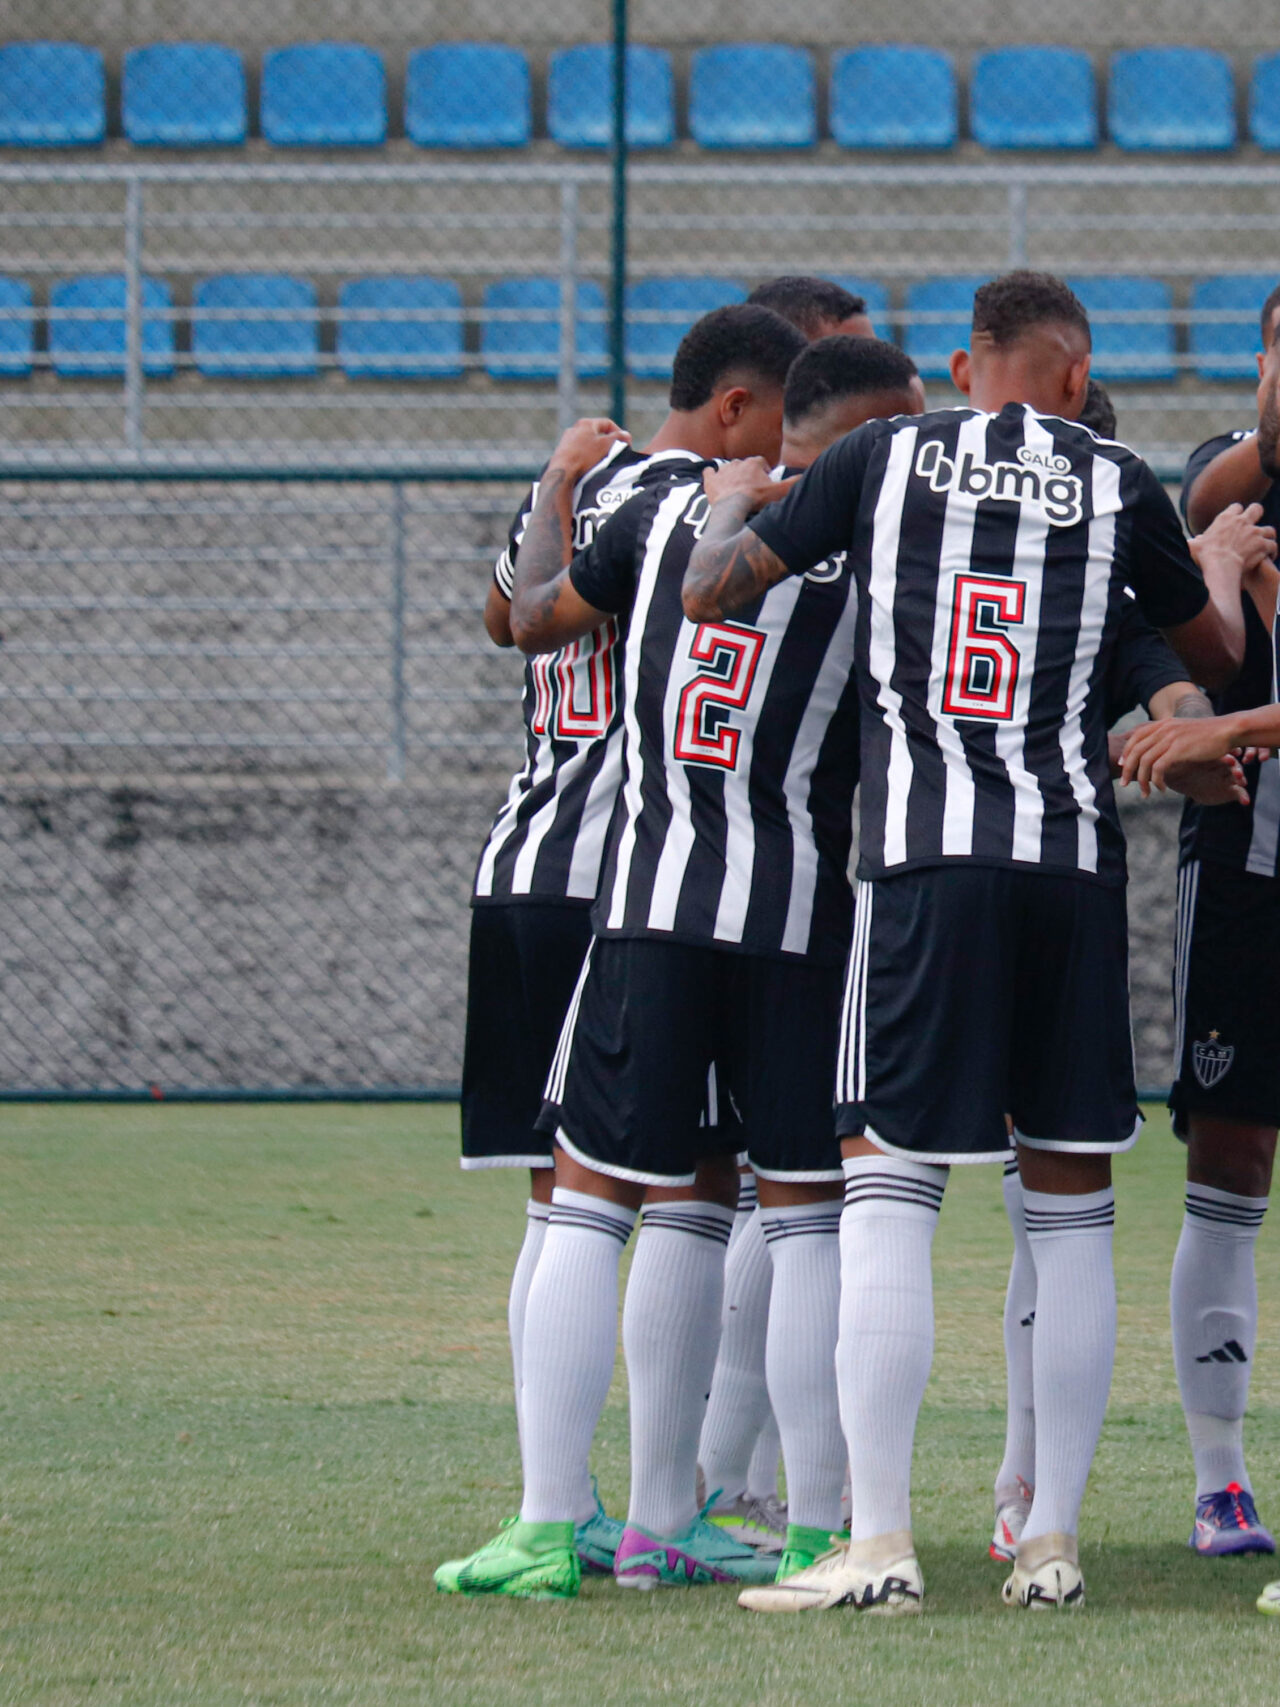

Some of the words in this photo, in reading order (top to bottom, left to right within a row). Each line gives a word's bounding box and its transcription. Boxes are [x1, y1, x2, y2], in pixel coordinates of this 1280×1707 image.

[957, 452, 1079, 523] bmg
[1019, 448, 1068, 473] GALO
[941, 572, 1027, 721] 6
[674, 621, 768, 771] 2
[1199, 1048, 1227, 1059] CAM
